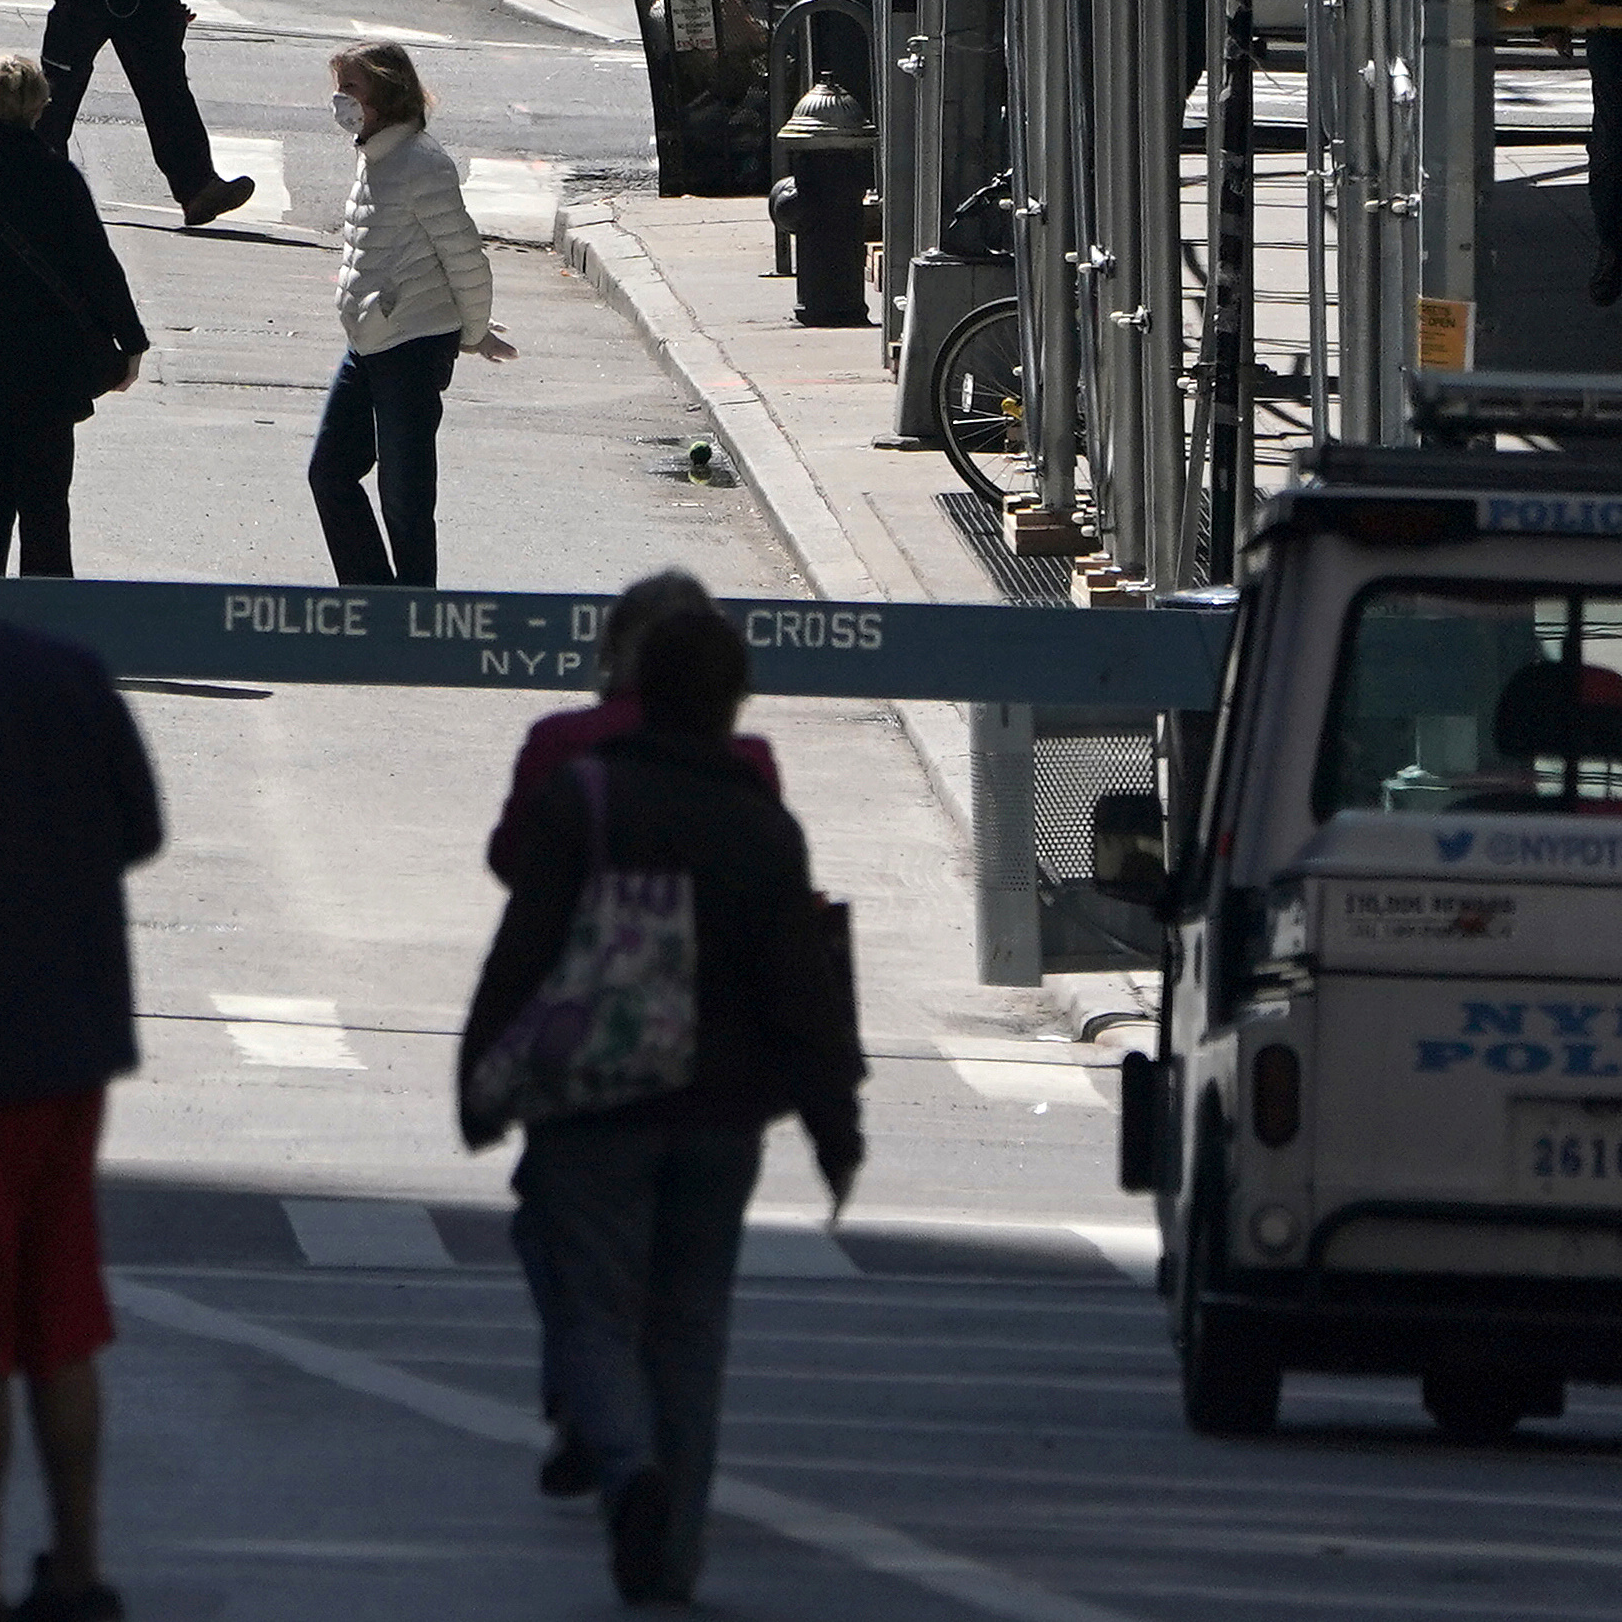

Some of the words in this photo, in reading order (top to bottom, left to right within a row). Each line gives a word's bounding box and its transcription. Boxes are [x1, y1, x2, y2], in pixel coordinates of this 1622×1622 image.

[223, 594, 368, 637] POLICE
[408, 601, 498, 641] LINE
[745, 609, 884, 651] CROSS
